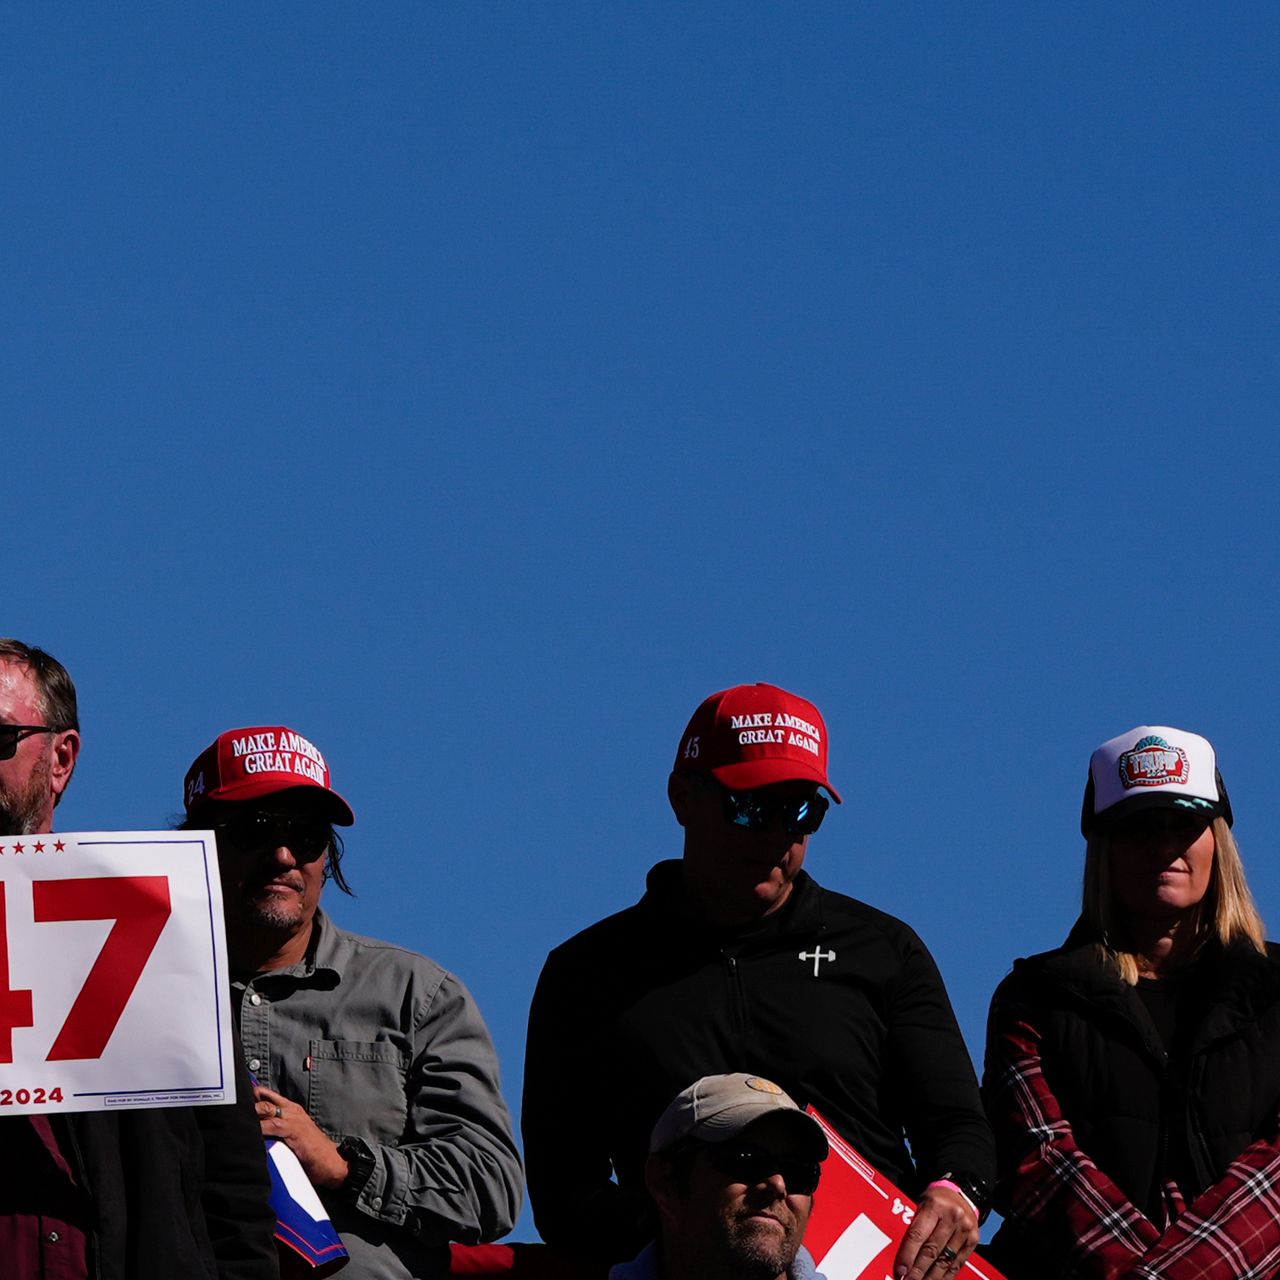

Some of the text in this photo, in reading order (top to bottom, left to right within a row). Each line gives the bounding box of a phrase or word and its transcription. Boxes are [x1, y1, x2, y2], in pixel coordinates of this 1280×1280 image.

[731, 713, 821, 743] MAKE AMERICA
[232, 732, 277, 757] MAKE
[684, 736, 700, 759] 45
[739, 729, 819, 757] GREAT AGAIN
[245, 752, 325, 787] GREAT AGAIN
[188, 772, 206, 804] 24
[0, 1087, 64, 1106] 2024
